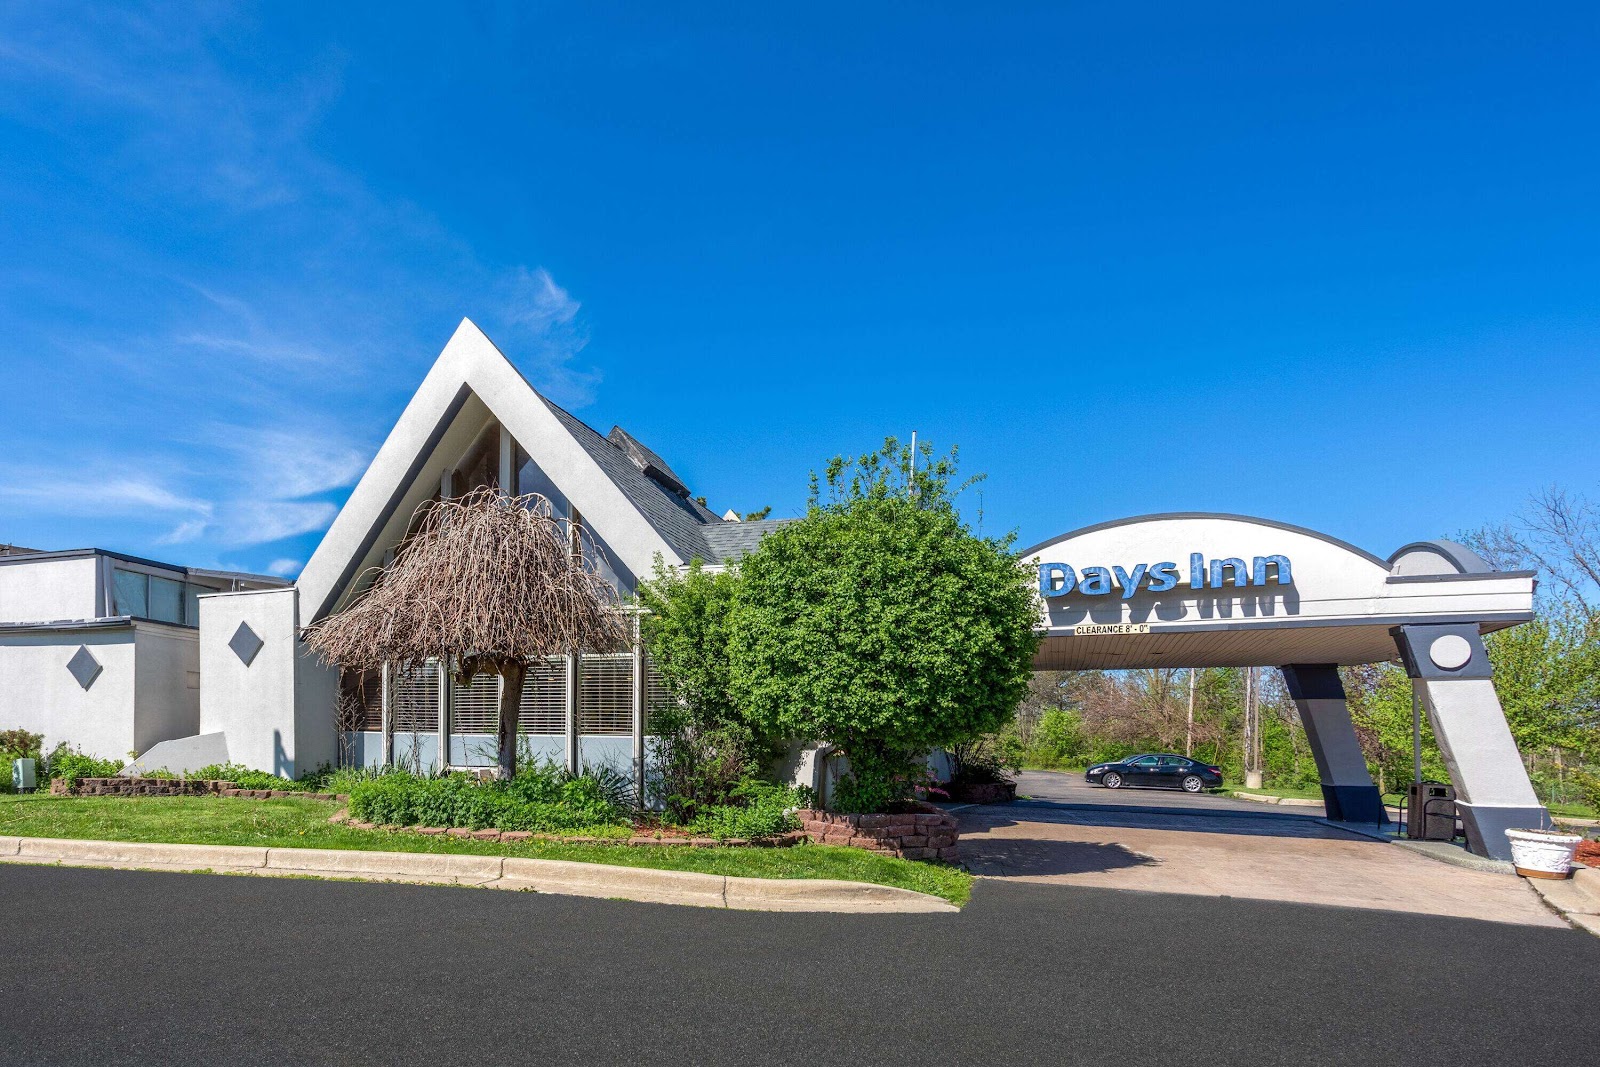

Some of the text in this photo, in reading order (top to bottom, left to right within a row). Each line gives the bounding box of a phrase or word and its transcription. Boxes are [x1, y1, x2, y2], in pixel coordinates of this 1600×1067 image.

[1039, 552, 1291, 599] Days Inn
[1076, 625, 1123, 634] CLEARANCE
